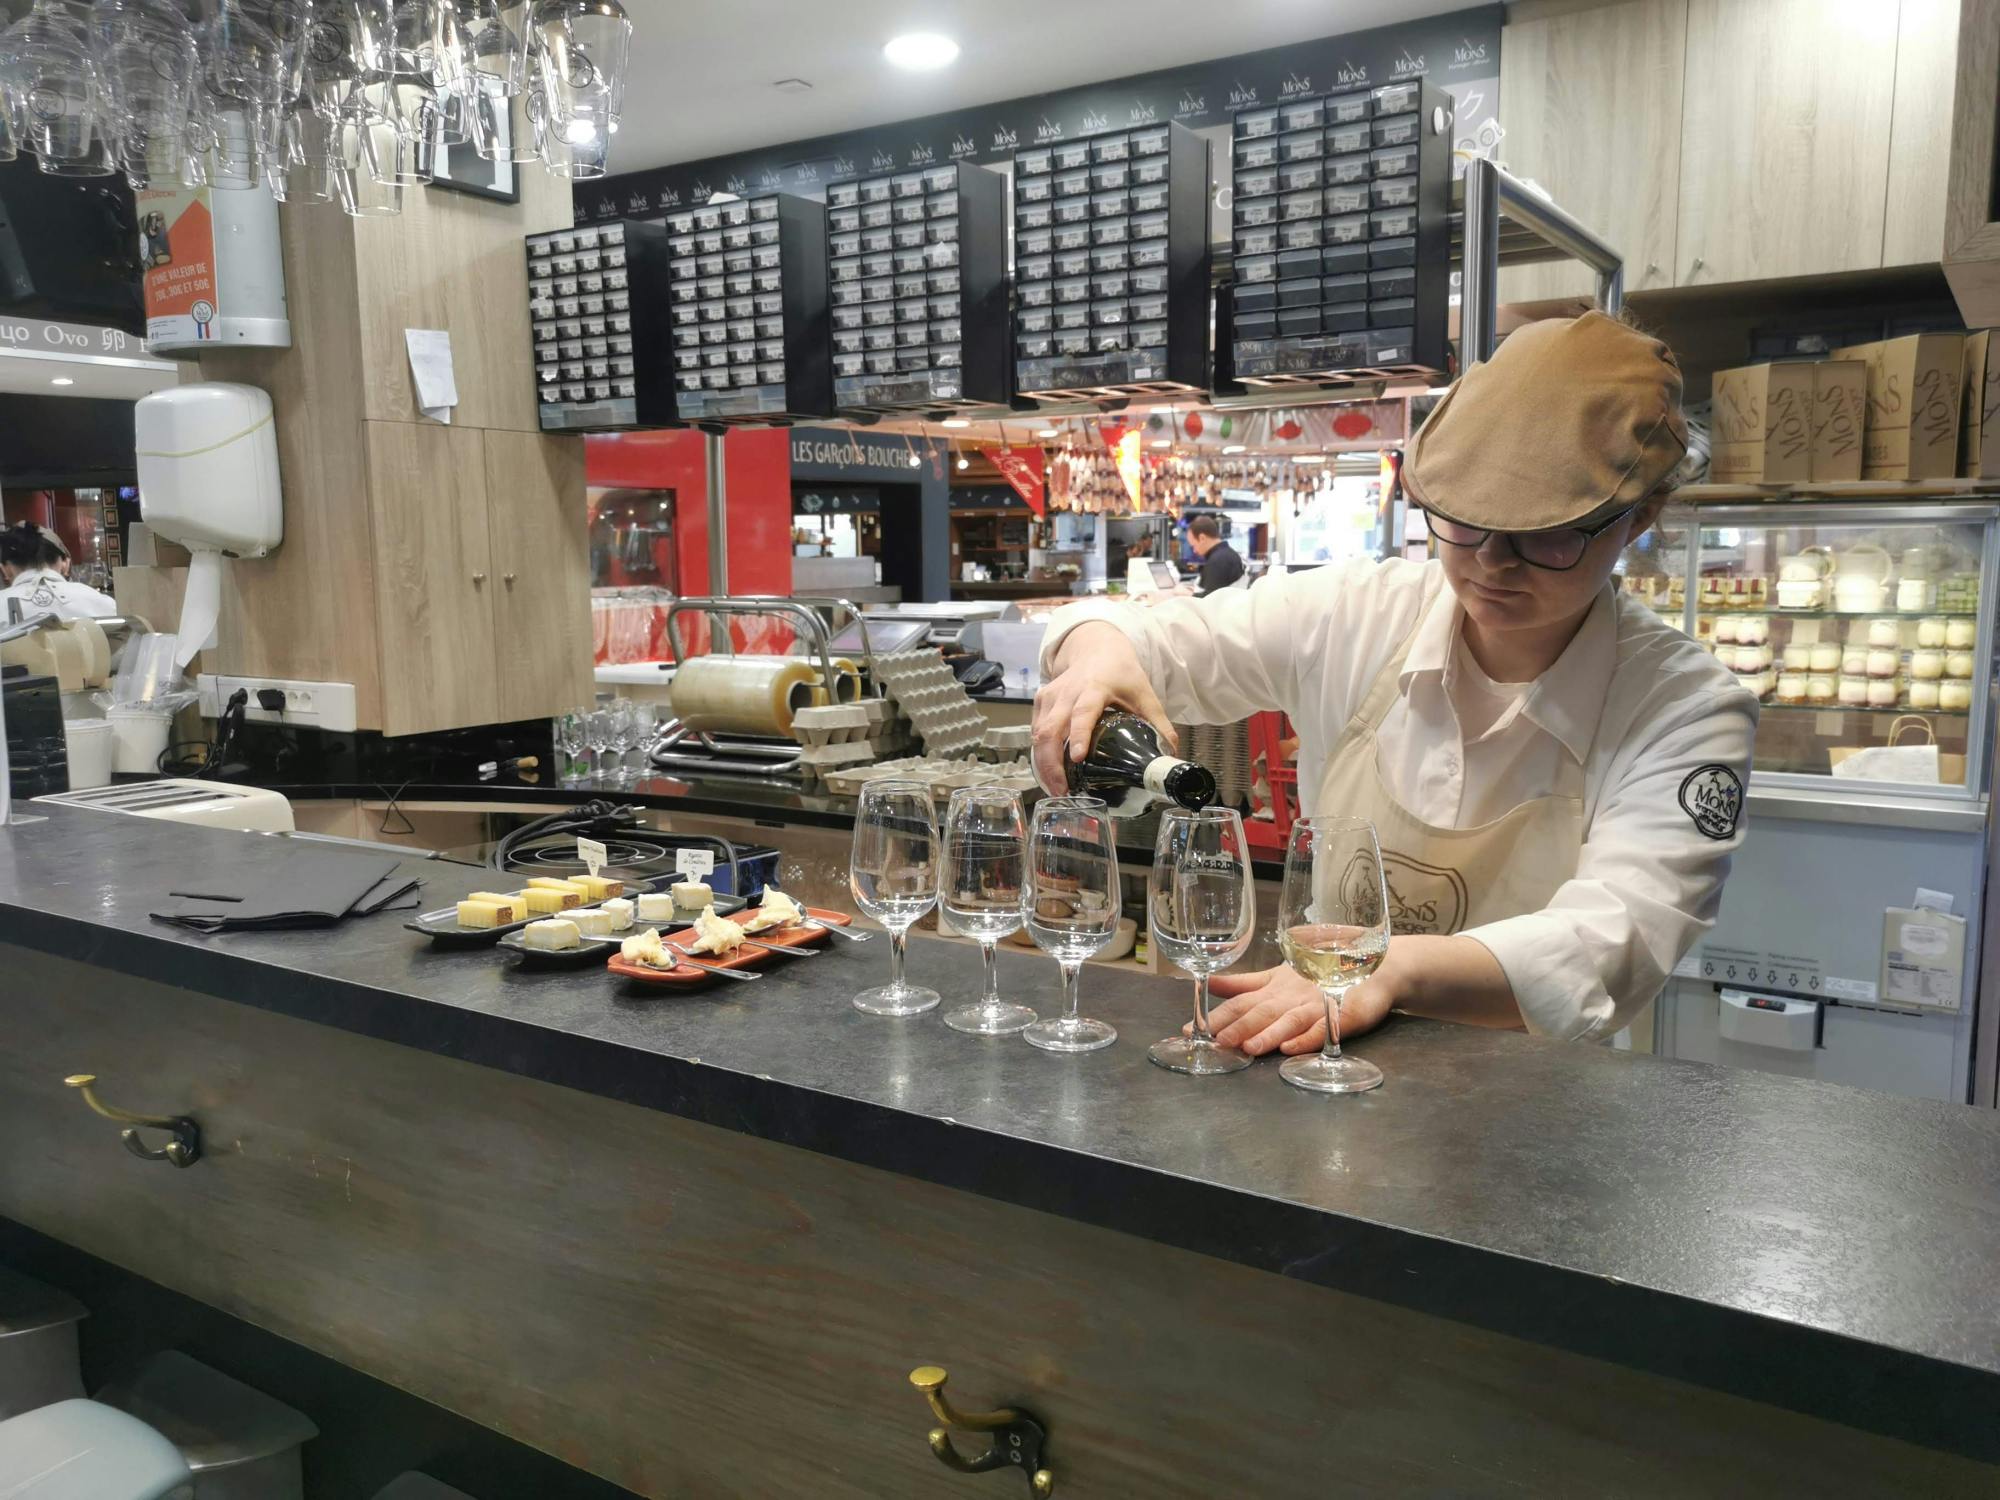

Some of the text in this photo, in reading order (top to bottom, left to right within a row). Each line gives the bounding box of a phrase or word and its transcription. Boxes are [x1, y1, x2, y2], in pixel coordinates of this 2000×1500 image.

[1454, 44, 1485, 63] MONS
[1394, 55, 1424, 74] MONS
[1337, 66, 1366, 84] MONS
[1282, 77, 1310, 95] MONS
[1178, 97, 1205, 114] MONS
[1229, 88, 1256, 105] MONS
[1130, 105, 1156, 122] MONS
[197, 262, 208, 275] DE
[43, 325, 89, 347] Ovo
[792, 440, 812, 463] LES
[1693, 784, 1736, 818] MONS
